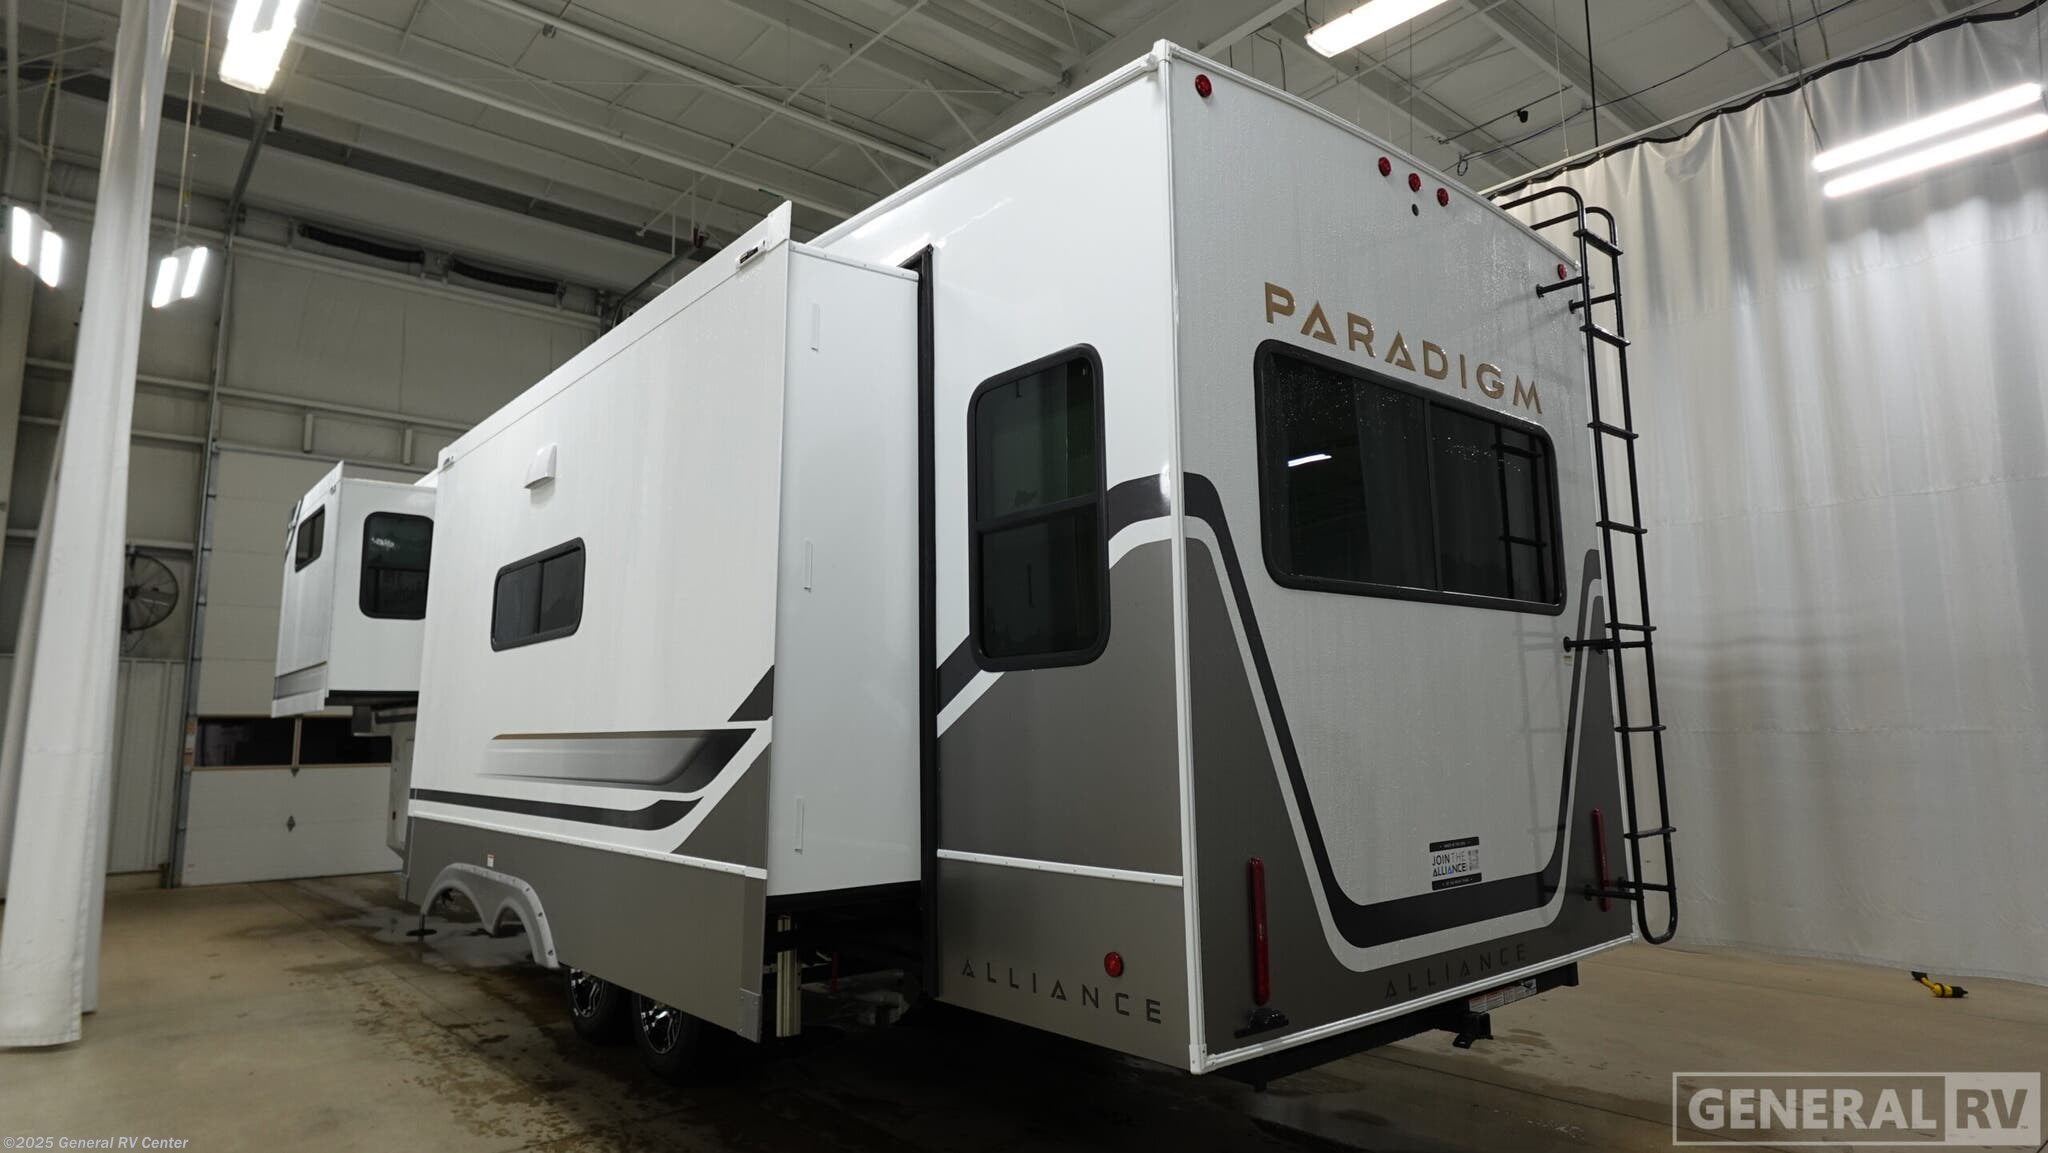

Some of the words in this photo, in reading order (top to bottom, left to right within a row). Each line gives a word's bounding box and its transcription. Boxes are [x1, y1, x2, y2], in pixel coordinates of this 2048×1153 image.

[1264, 281, 1543, 415] PARADIGM
[1432, 854, 1450, 867] JOIN
[1451, 850, 1466, 863] THE
[1432, 862, 1467, 877] ALLIANCE
[961, 959, 1162, 1025] ALLIANCE
[1384, 943, 1529, 1000] ALLIANCE
